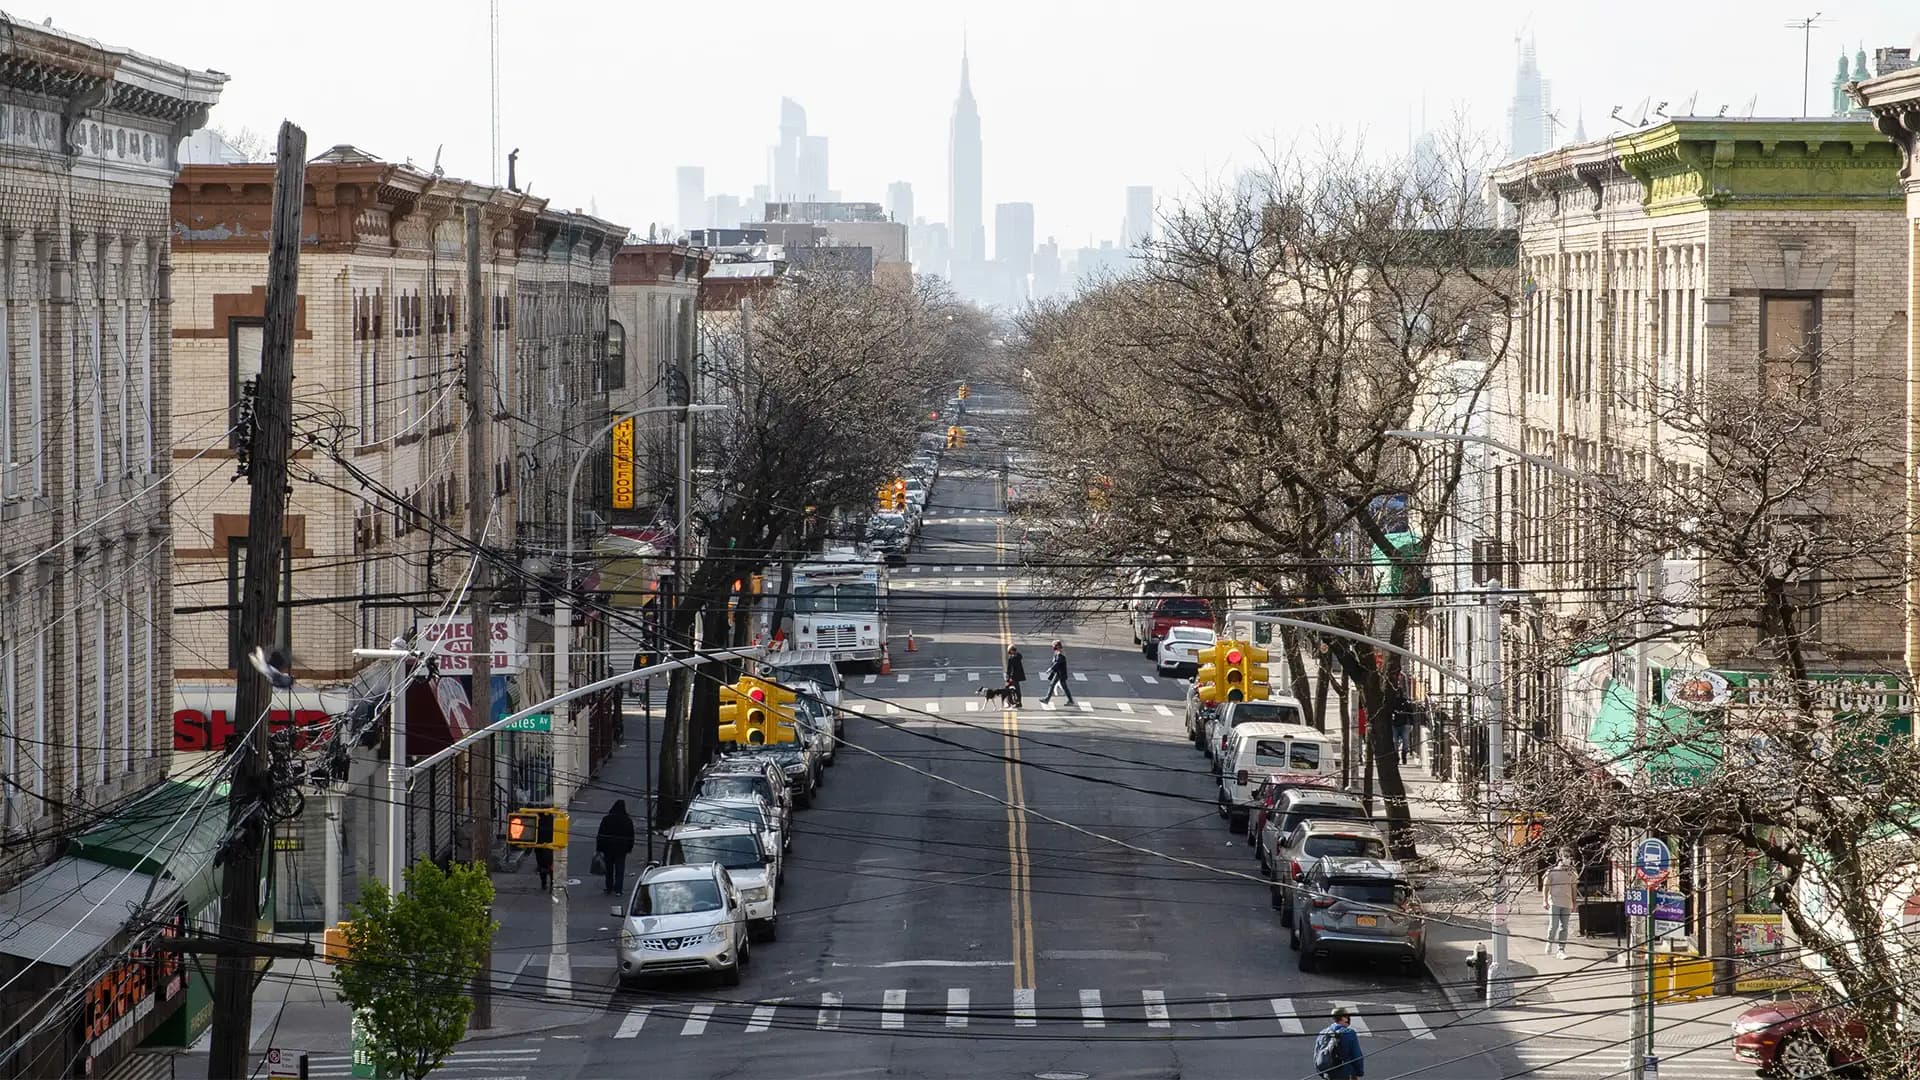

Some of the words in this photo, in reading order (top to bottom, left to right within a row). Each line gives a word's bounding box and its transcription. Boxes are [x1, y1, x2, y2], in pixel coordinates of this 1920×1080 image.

[617, 418, 630, 469] HINESE
[616, 470, 630, 502] FOOD
[425, 622, 508, 641] CHECS
[434, 651, 508, 670] ASD
[505, 718, 536, 729] ates
